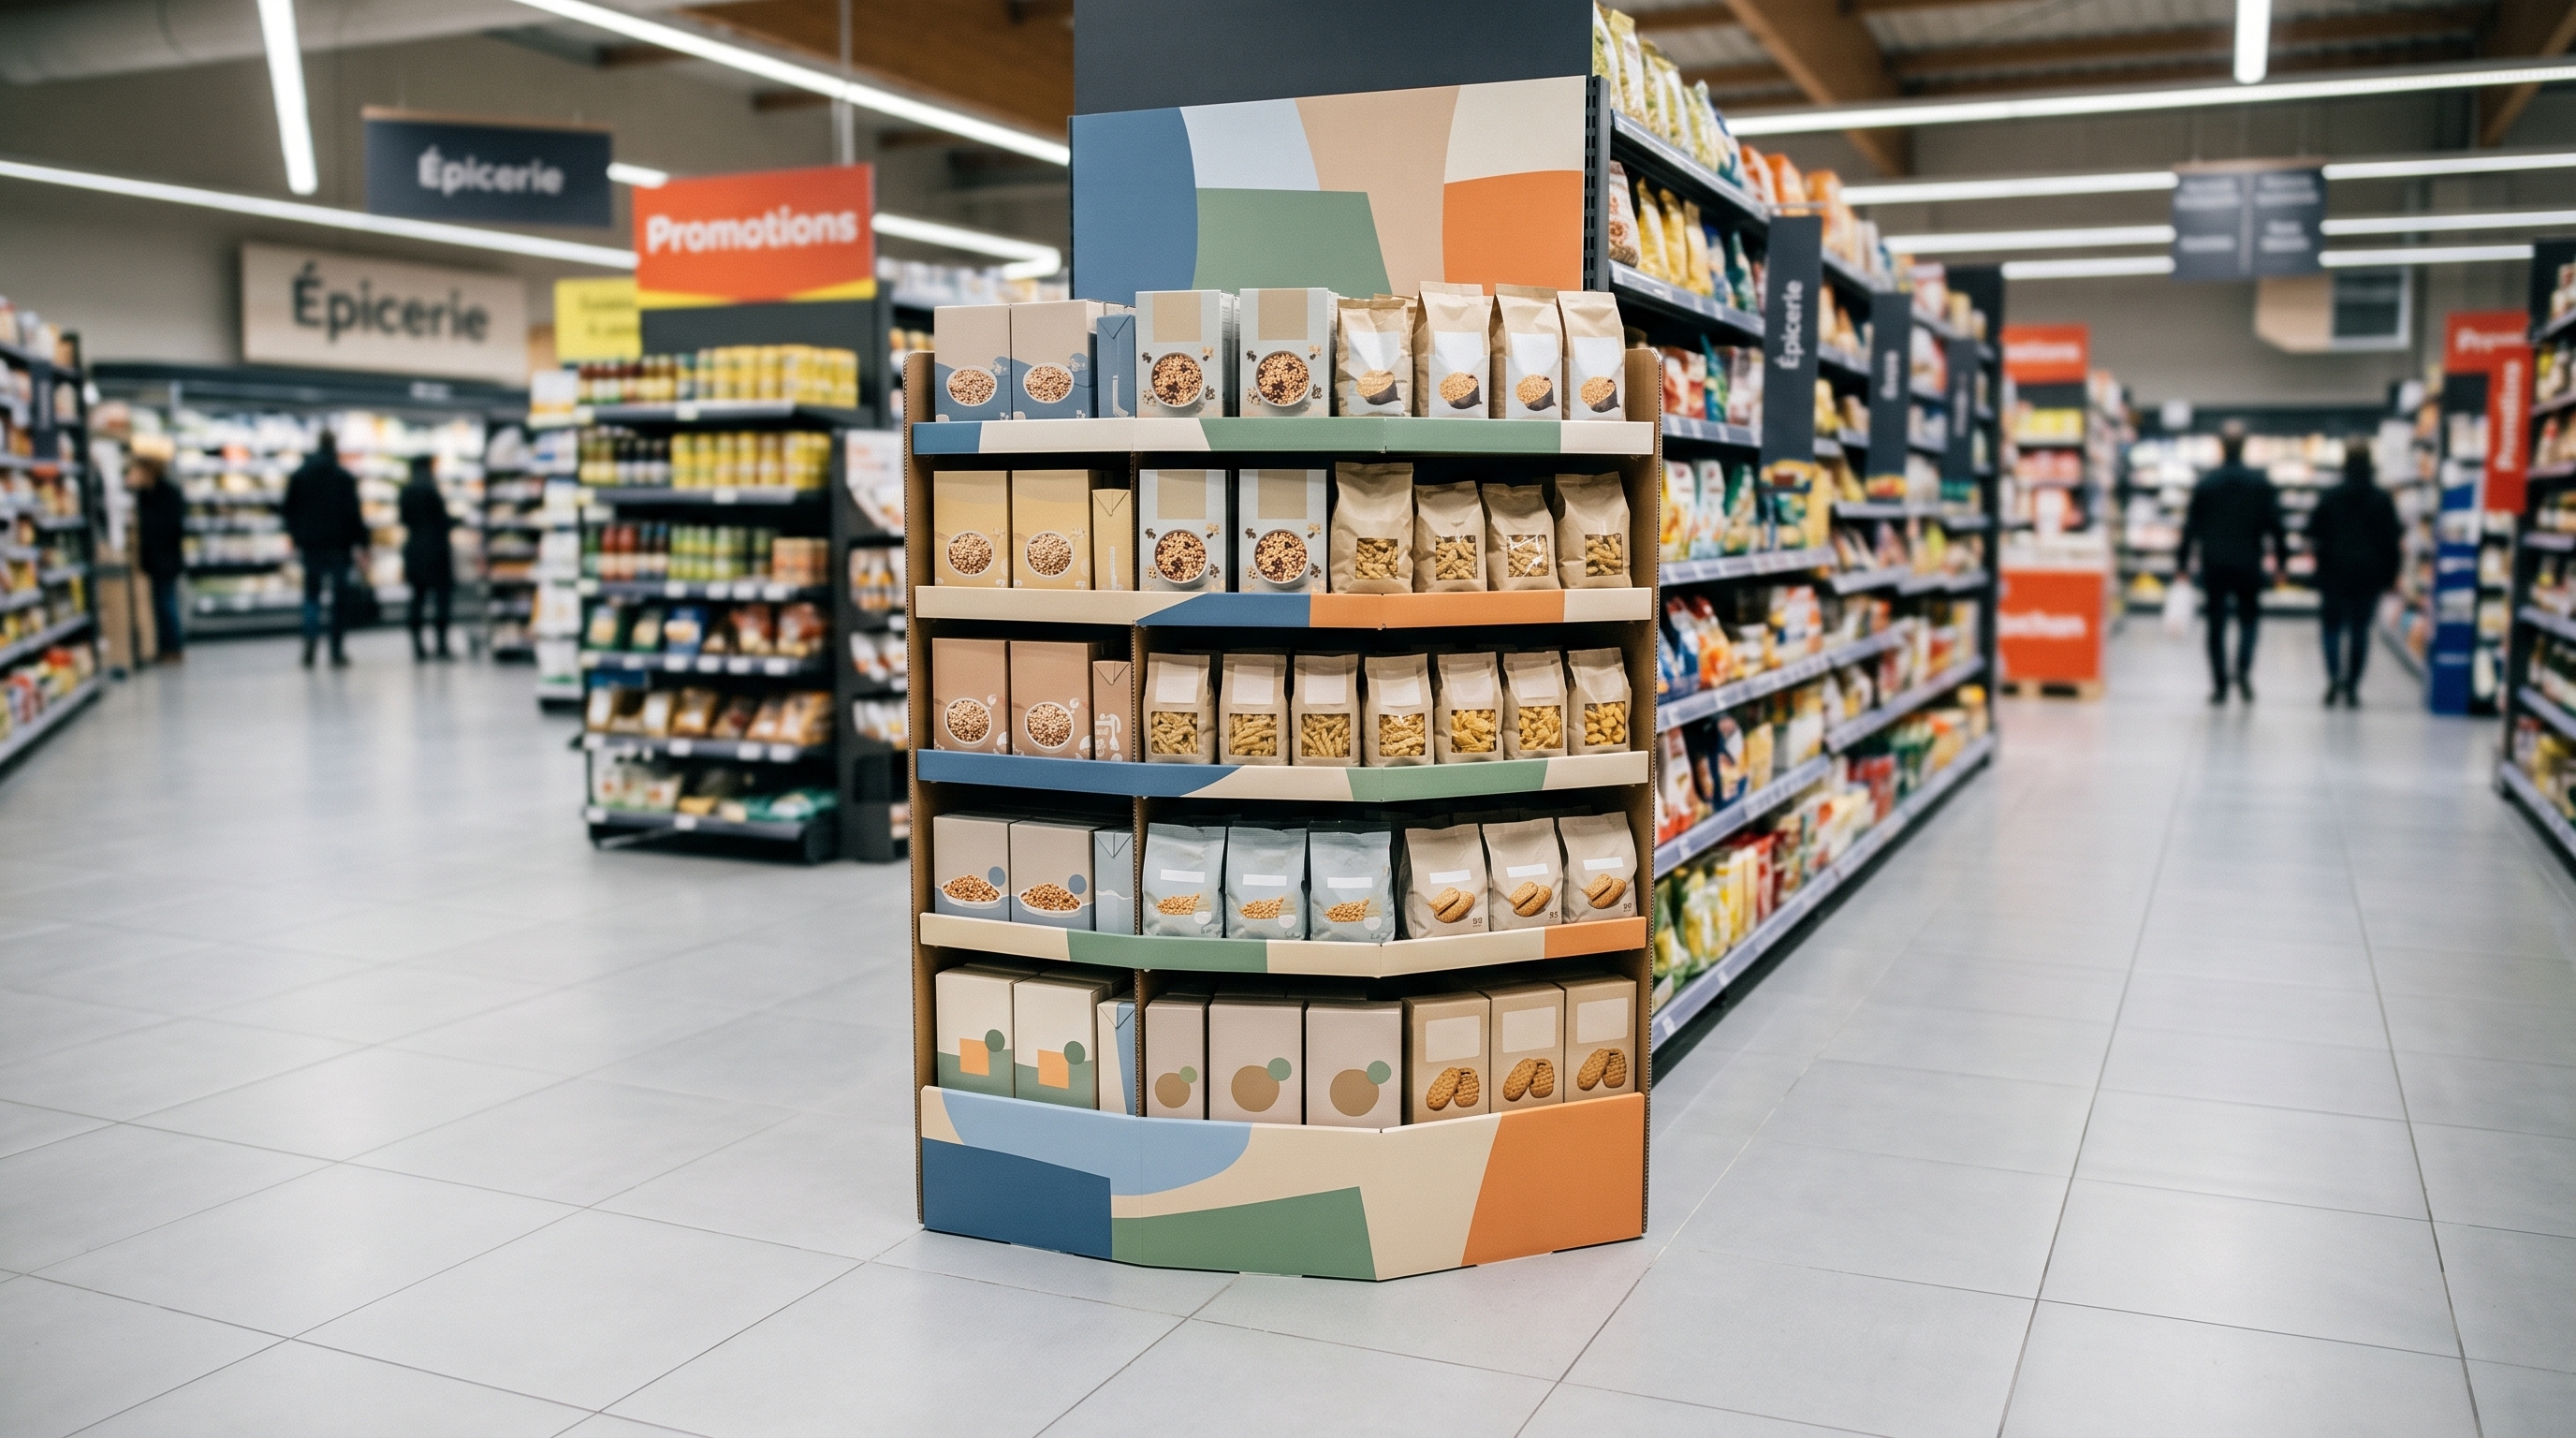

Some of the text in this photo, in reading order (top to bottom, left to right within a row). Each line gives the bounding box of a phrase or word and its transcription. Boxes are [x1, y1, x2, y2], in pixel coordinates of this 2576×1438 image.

[418, 144, 564, 197] Épicerie
[647, 205, 857, 254] Promotions
[294, 261, 490, 344] Épicerie
[1776, 280, 1804, 369] Épicerie
